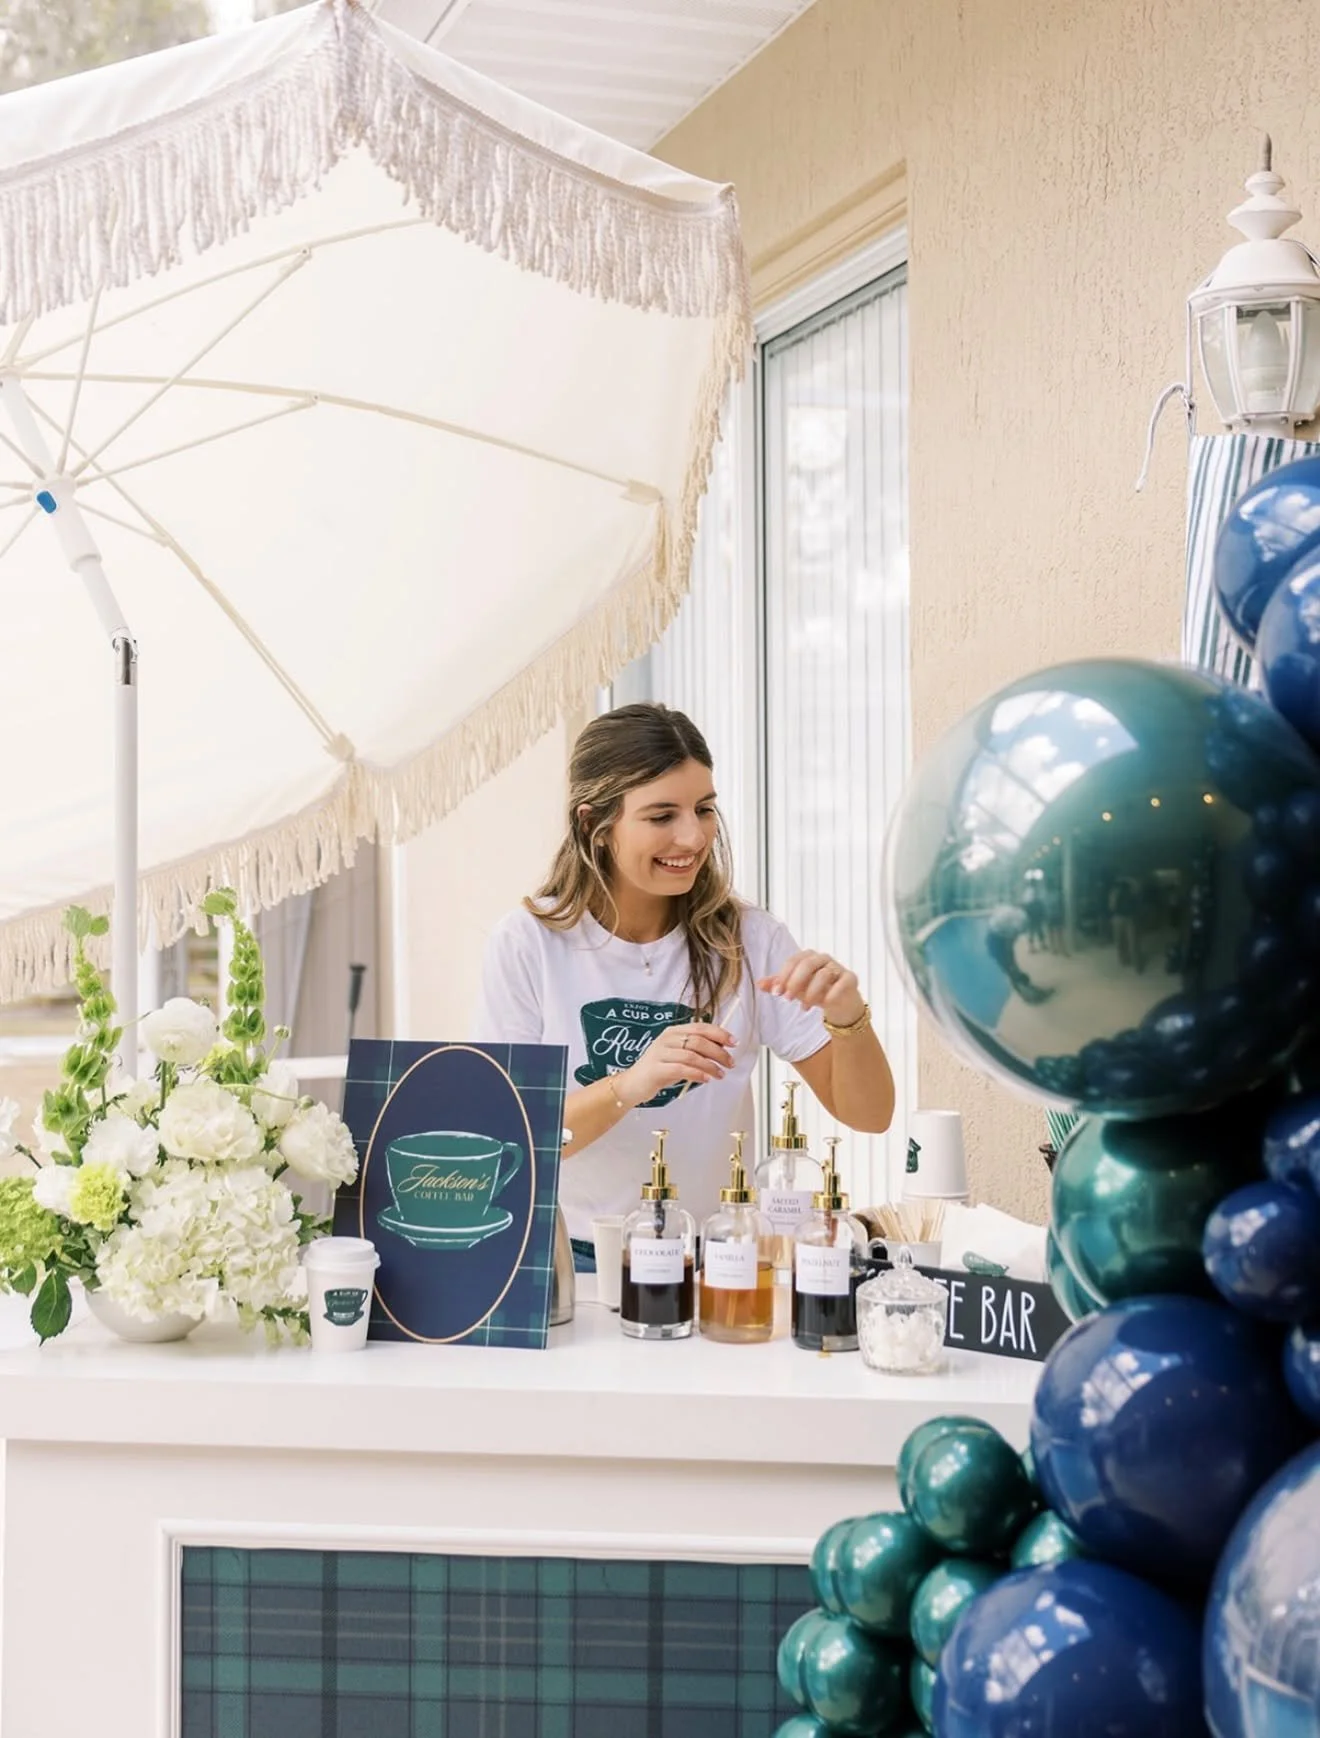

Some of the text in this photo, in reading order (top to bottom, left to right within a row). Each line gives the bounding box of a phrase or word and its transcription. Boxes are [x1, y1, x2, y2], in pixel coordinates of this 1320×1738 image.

[606, 1008, 673, 1020] A CUP OF
[397, 1163, 491, 1193] Jackson's
[414, 1191, 475, 1201] COFFEE BAR
[981, 1286, 1036, 1353] BAR
